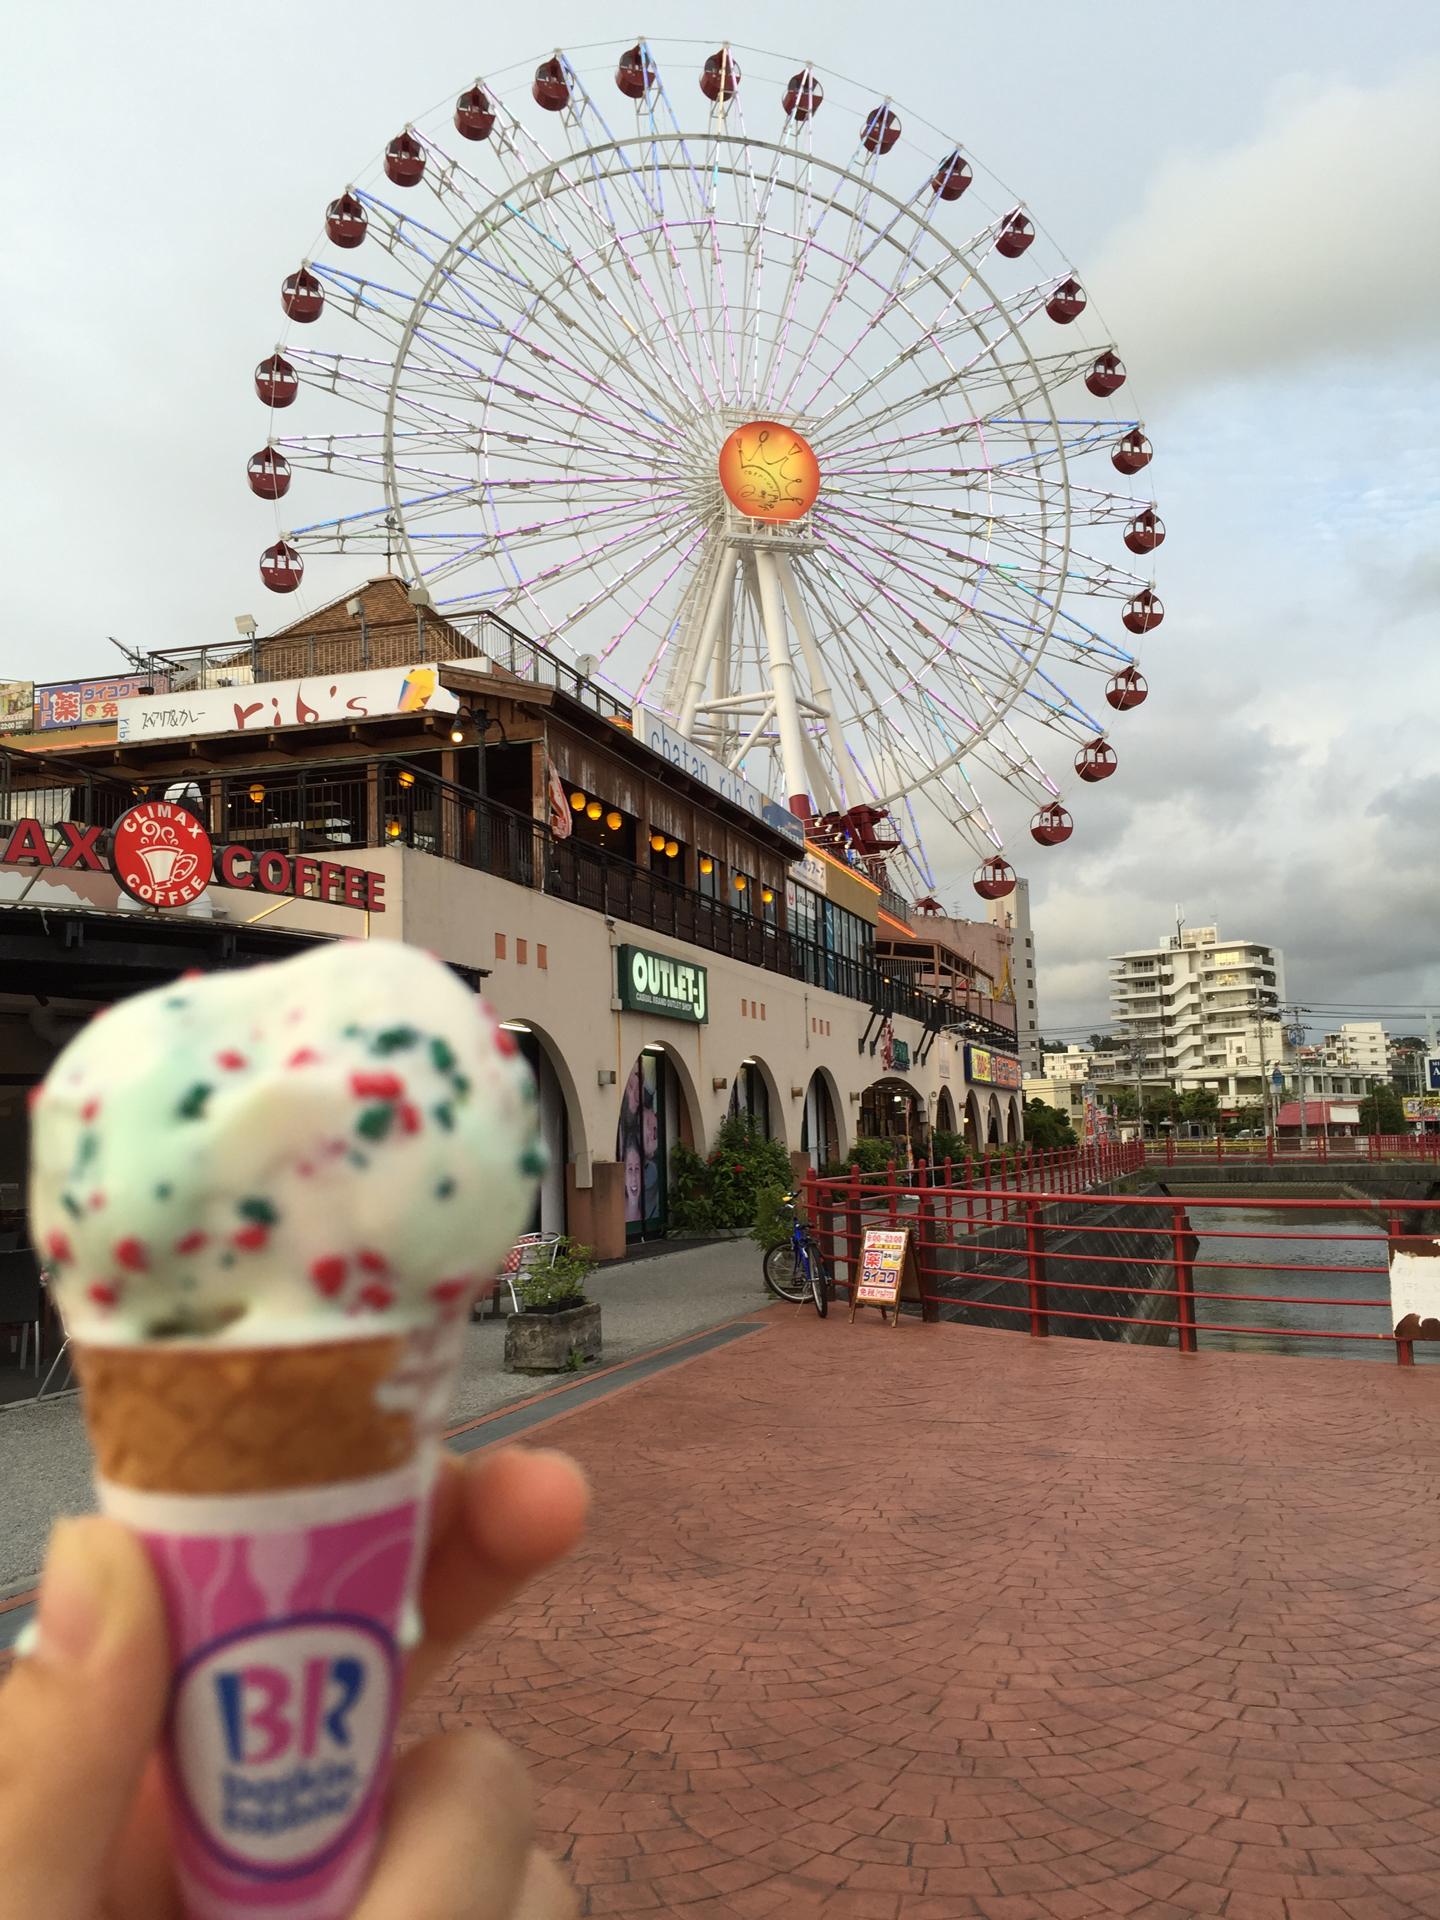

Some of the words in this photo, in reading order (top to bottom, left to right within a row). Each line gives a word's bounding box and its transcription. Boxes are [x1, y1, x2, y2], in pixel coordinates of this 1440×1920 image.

[53, 690, 80, 722] 薬
[233, 680, 368, 730] rib's
[123, 804, 205, 840] CLIMAX
[2, 817, 106, 872] AX
[221, 844, 386, 913] COFFEE
[125, 873, 206, 906] COFFEE
[632, 951, 706, 1019] OUTLET-J
[213, 1654, 366, 1766] BR
